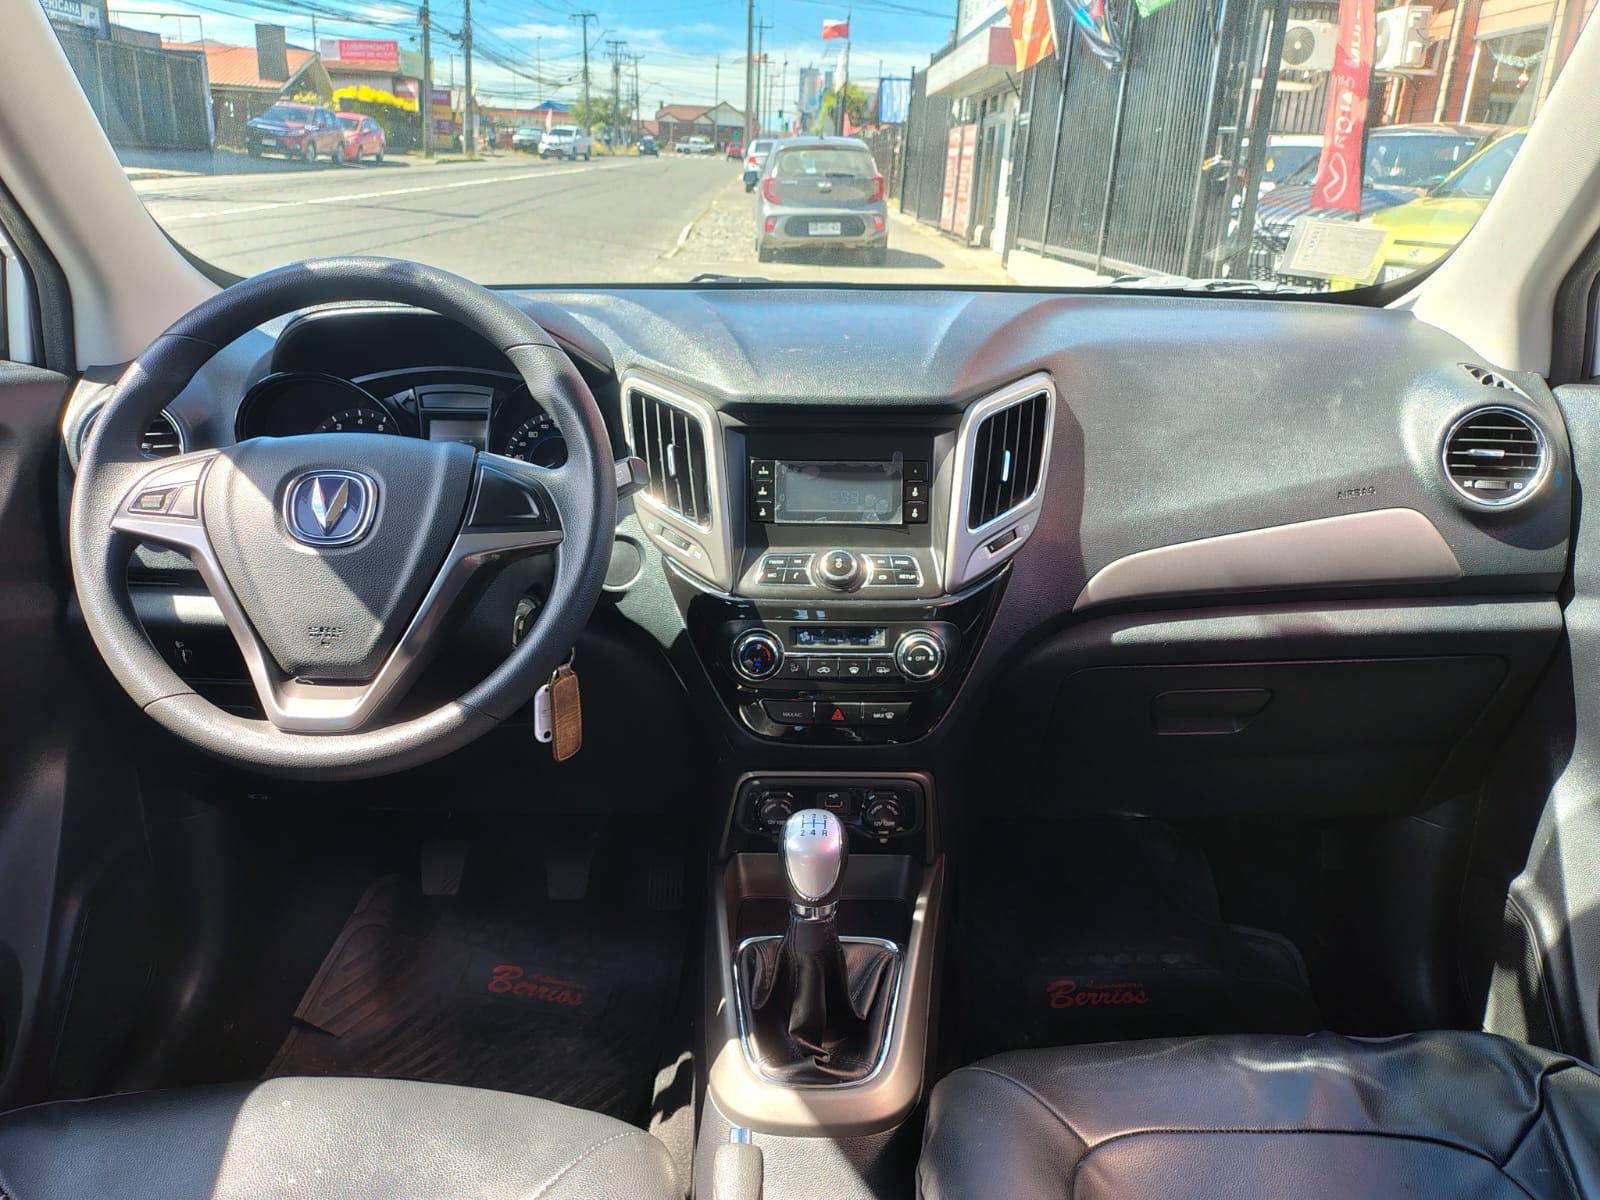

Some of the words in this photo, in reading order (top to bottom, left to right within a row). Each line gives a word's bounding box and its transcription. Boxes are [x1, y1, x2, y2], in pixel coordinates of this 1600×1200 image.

[336, 423, 342, 431] 3
[378, 424, 384, 432] 5
[1046, 979, 1149, 1009] Berrios
